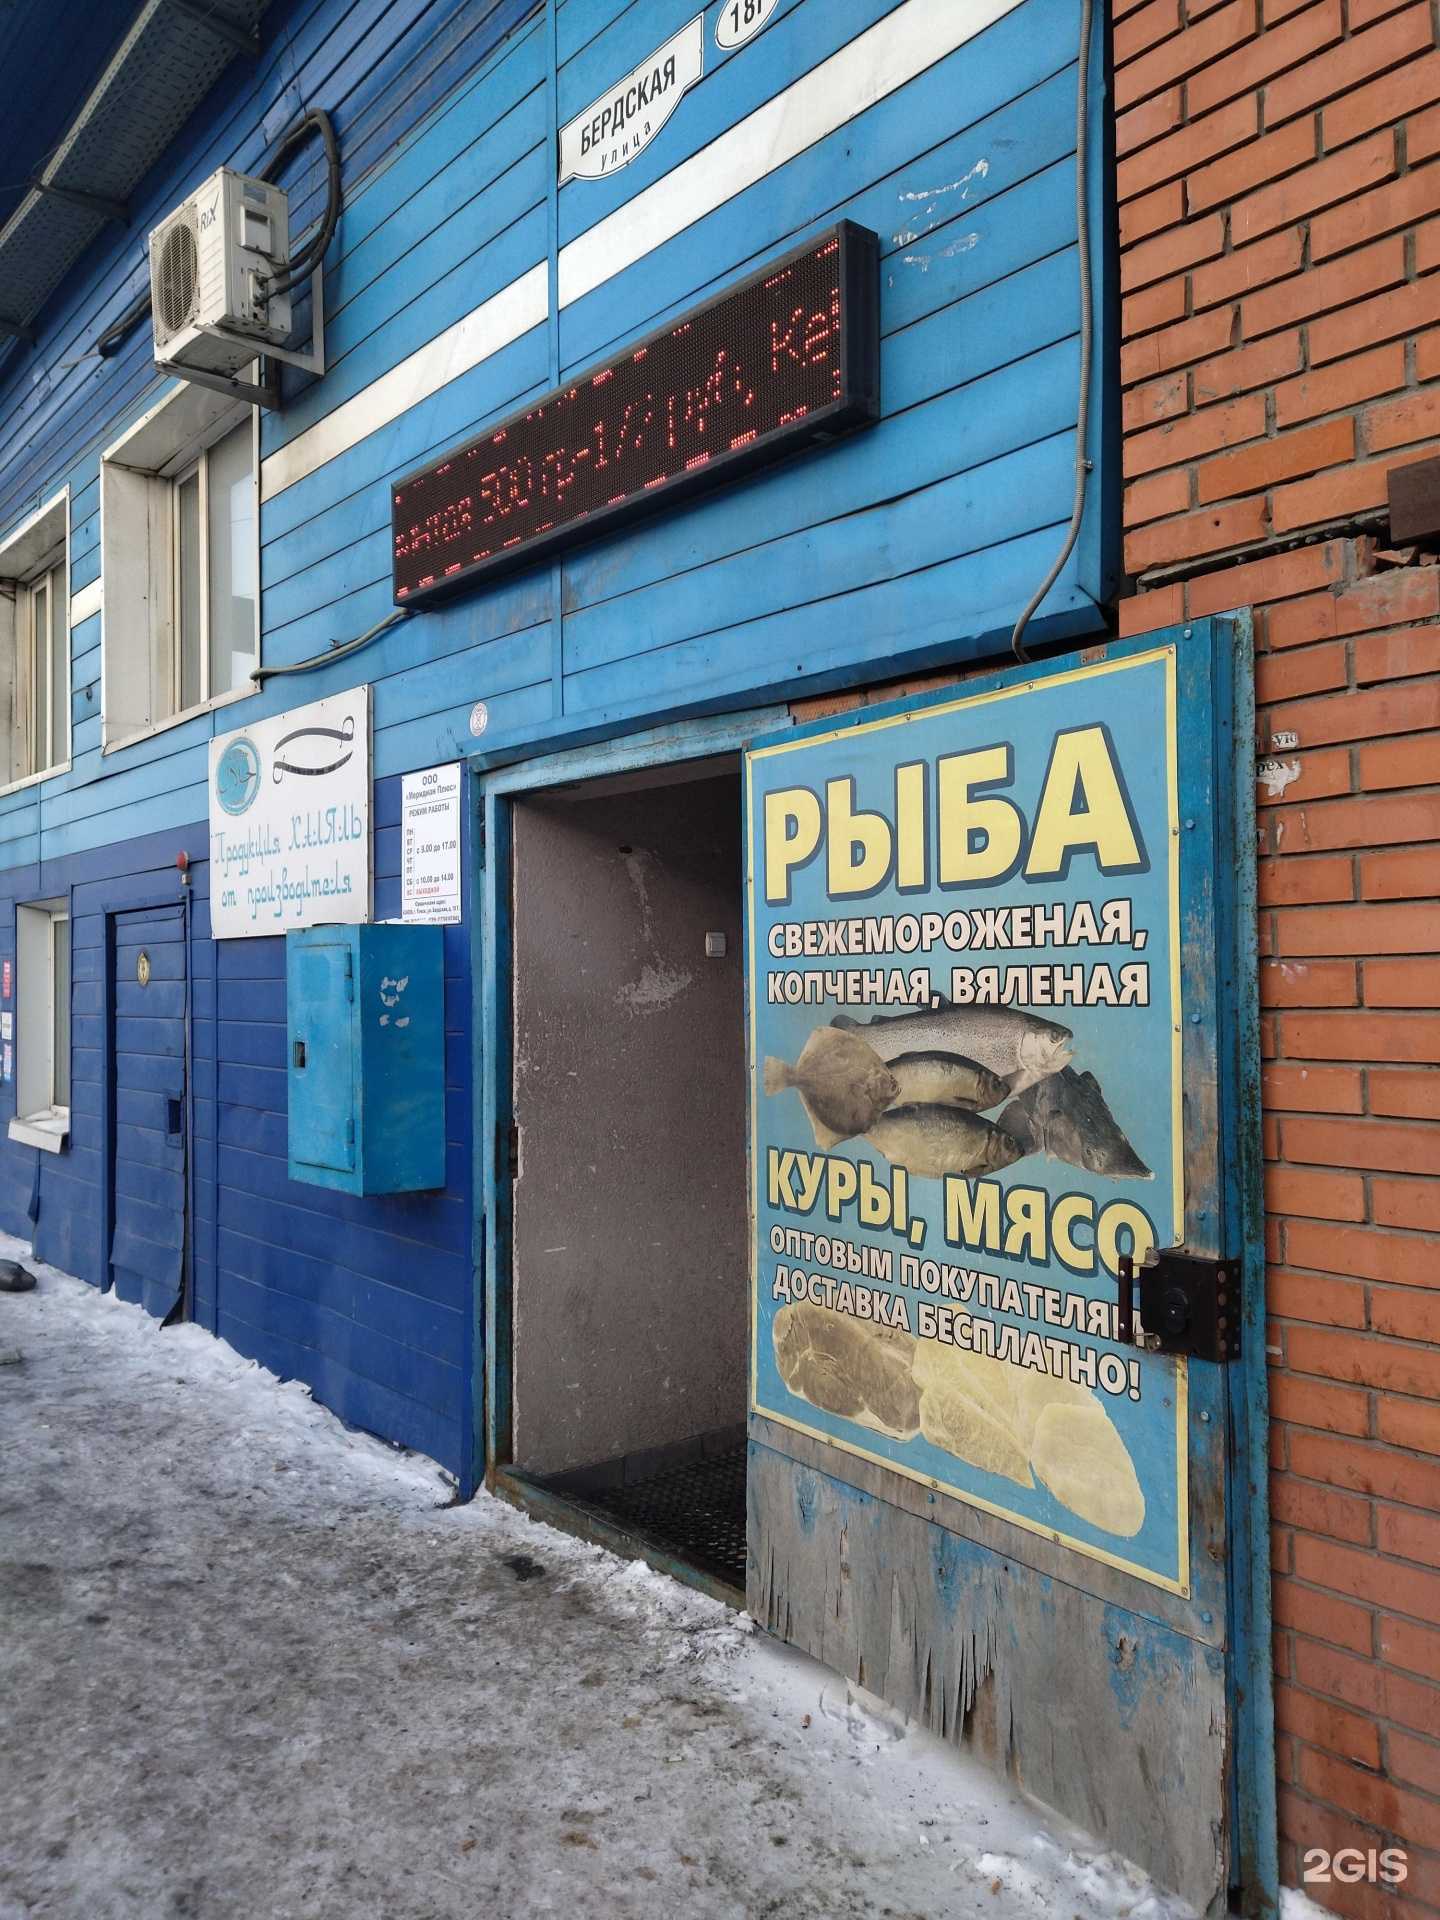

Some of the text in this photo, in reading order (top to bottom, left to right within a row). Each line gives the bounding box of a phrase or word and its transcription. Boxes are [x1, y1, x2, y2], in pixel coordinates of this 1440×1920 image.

[580, 54, 676, 156] БЕРДСКАЯ
[600, 120, 651, 171] улица
[422, 773, 438, 786] ООО
[428, 802, 450, 814] РАБОТЫ
[764, 722, 1149, 905] РЫБА
[214, 823, 281, 877] Продукция
[221, 859, 352, 919] от производителя
[767, 898, 1149, 958] СВЕЖЕМОРОЖЕНАЯ,
[767, 961, 1149, 1010] КОПЧЕНАЯ, ВЯЛЕНАЯ
[767, 1146, 1158, 1281] КУРЫ, МЯСО
[770, 1224, 894, 1283] ОПТОВЫМ
[772, 1264, 1142, 1402] ДОСТАВКА БЕСПЛАТНО!
